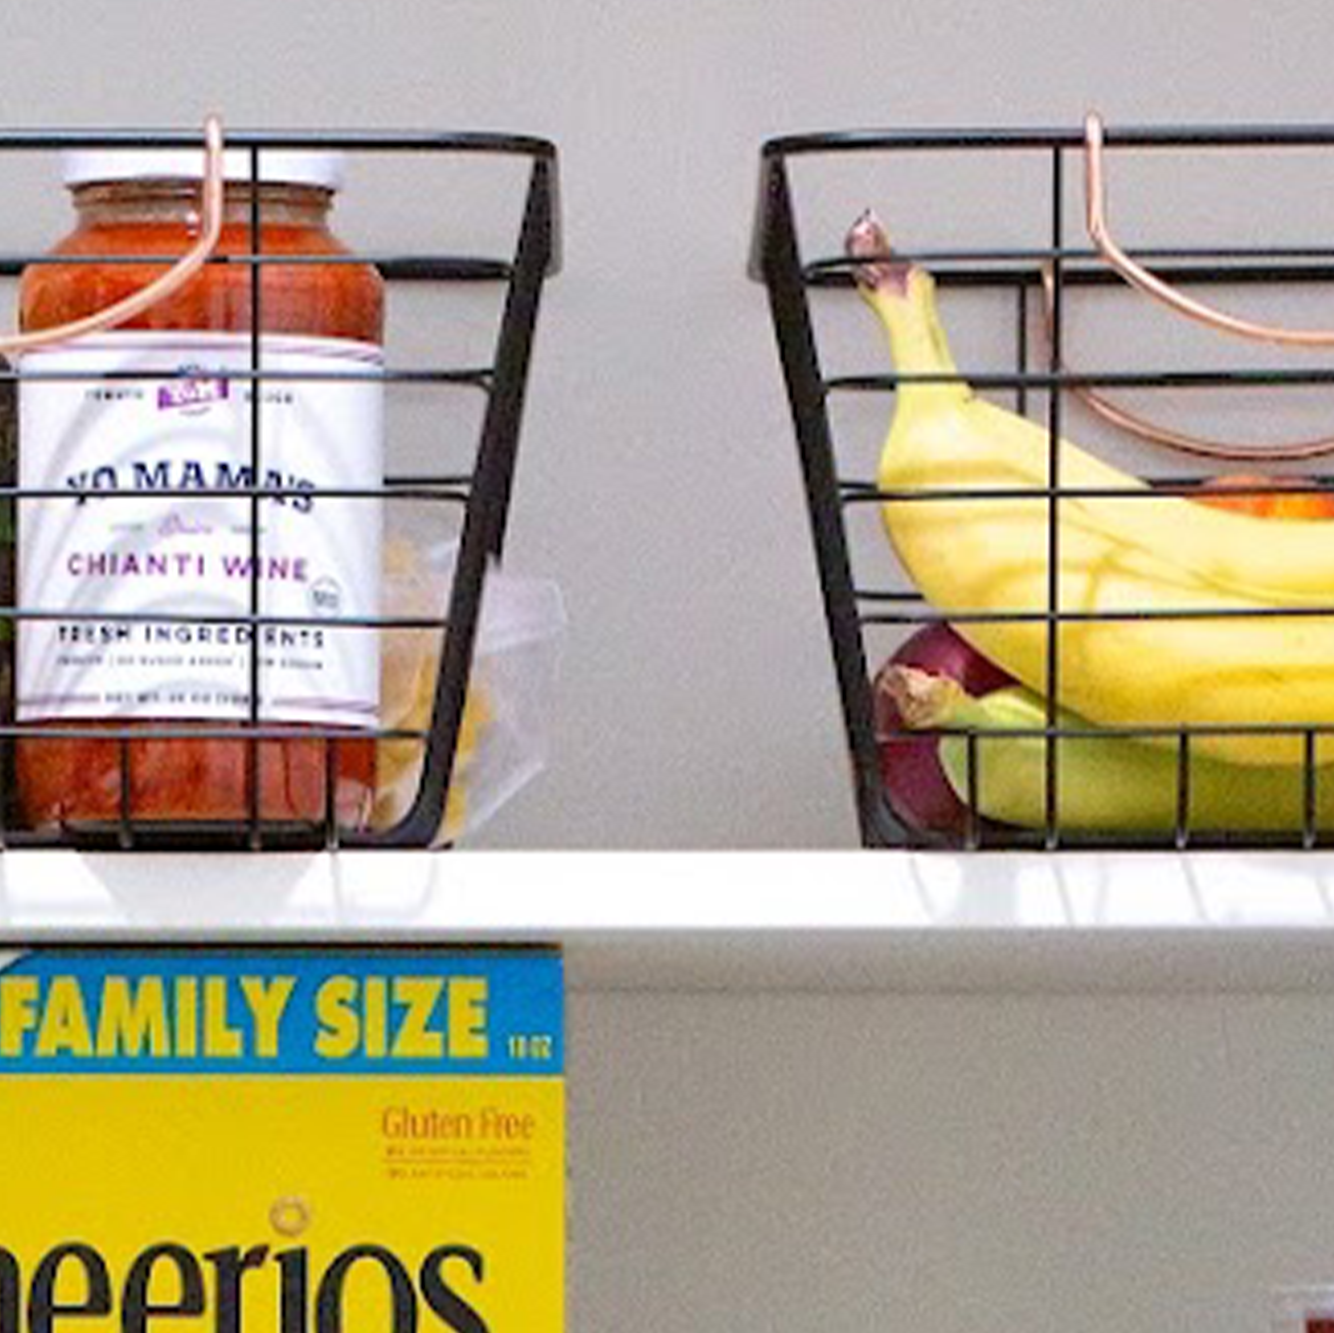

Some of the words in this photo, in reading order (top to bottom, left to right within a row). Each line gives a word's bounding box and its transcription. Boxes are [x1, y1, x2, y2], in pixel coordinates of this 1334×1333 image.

[67, 466, 118, 508] YO
[132, 461, 316, 515] MAMA'S
[68, 552, 205, 577] CHIANTI
[58, 624, 131, 645] FRESH
[145, 625, 324, 649] INGREDENTS
[313, 975, 489, 1058] SIZE
[382, 1105, 473, 1140] Gluten
[480, 1105, 535, 1140] Free
